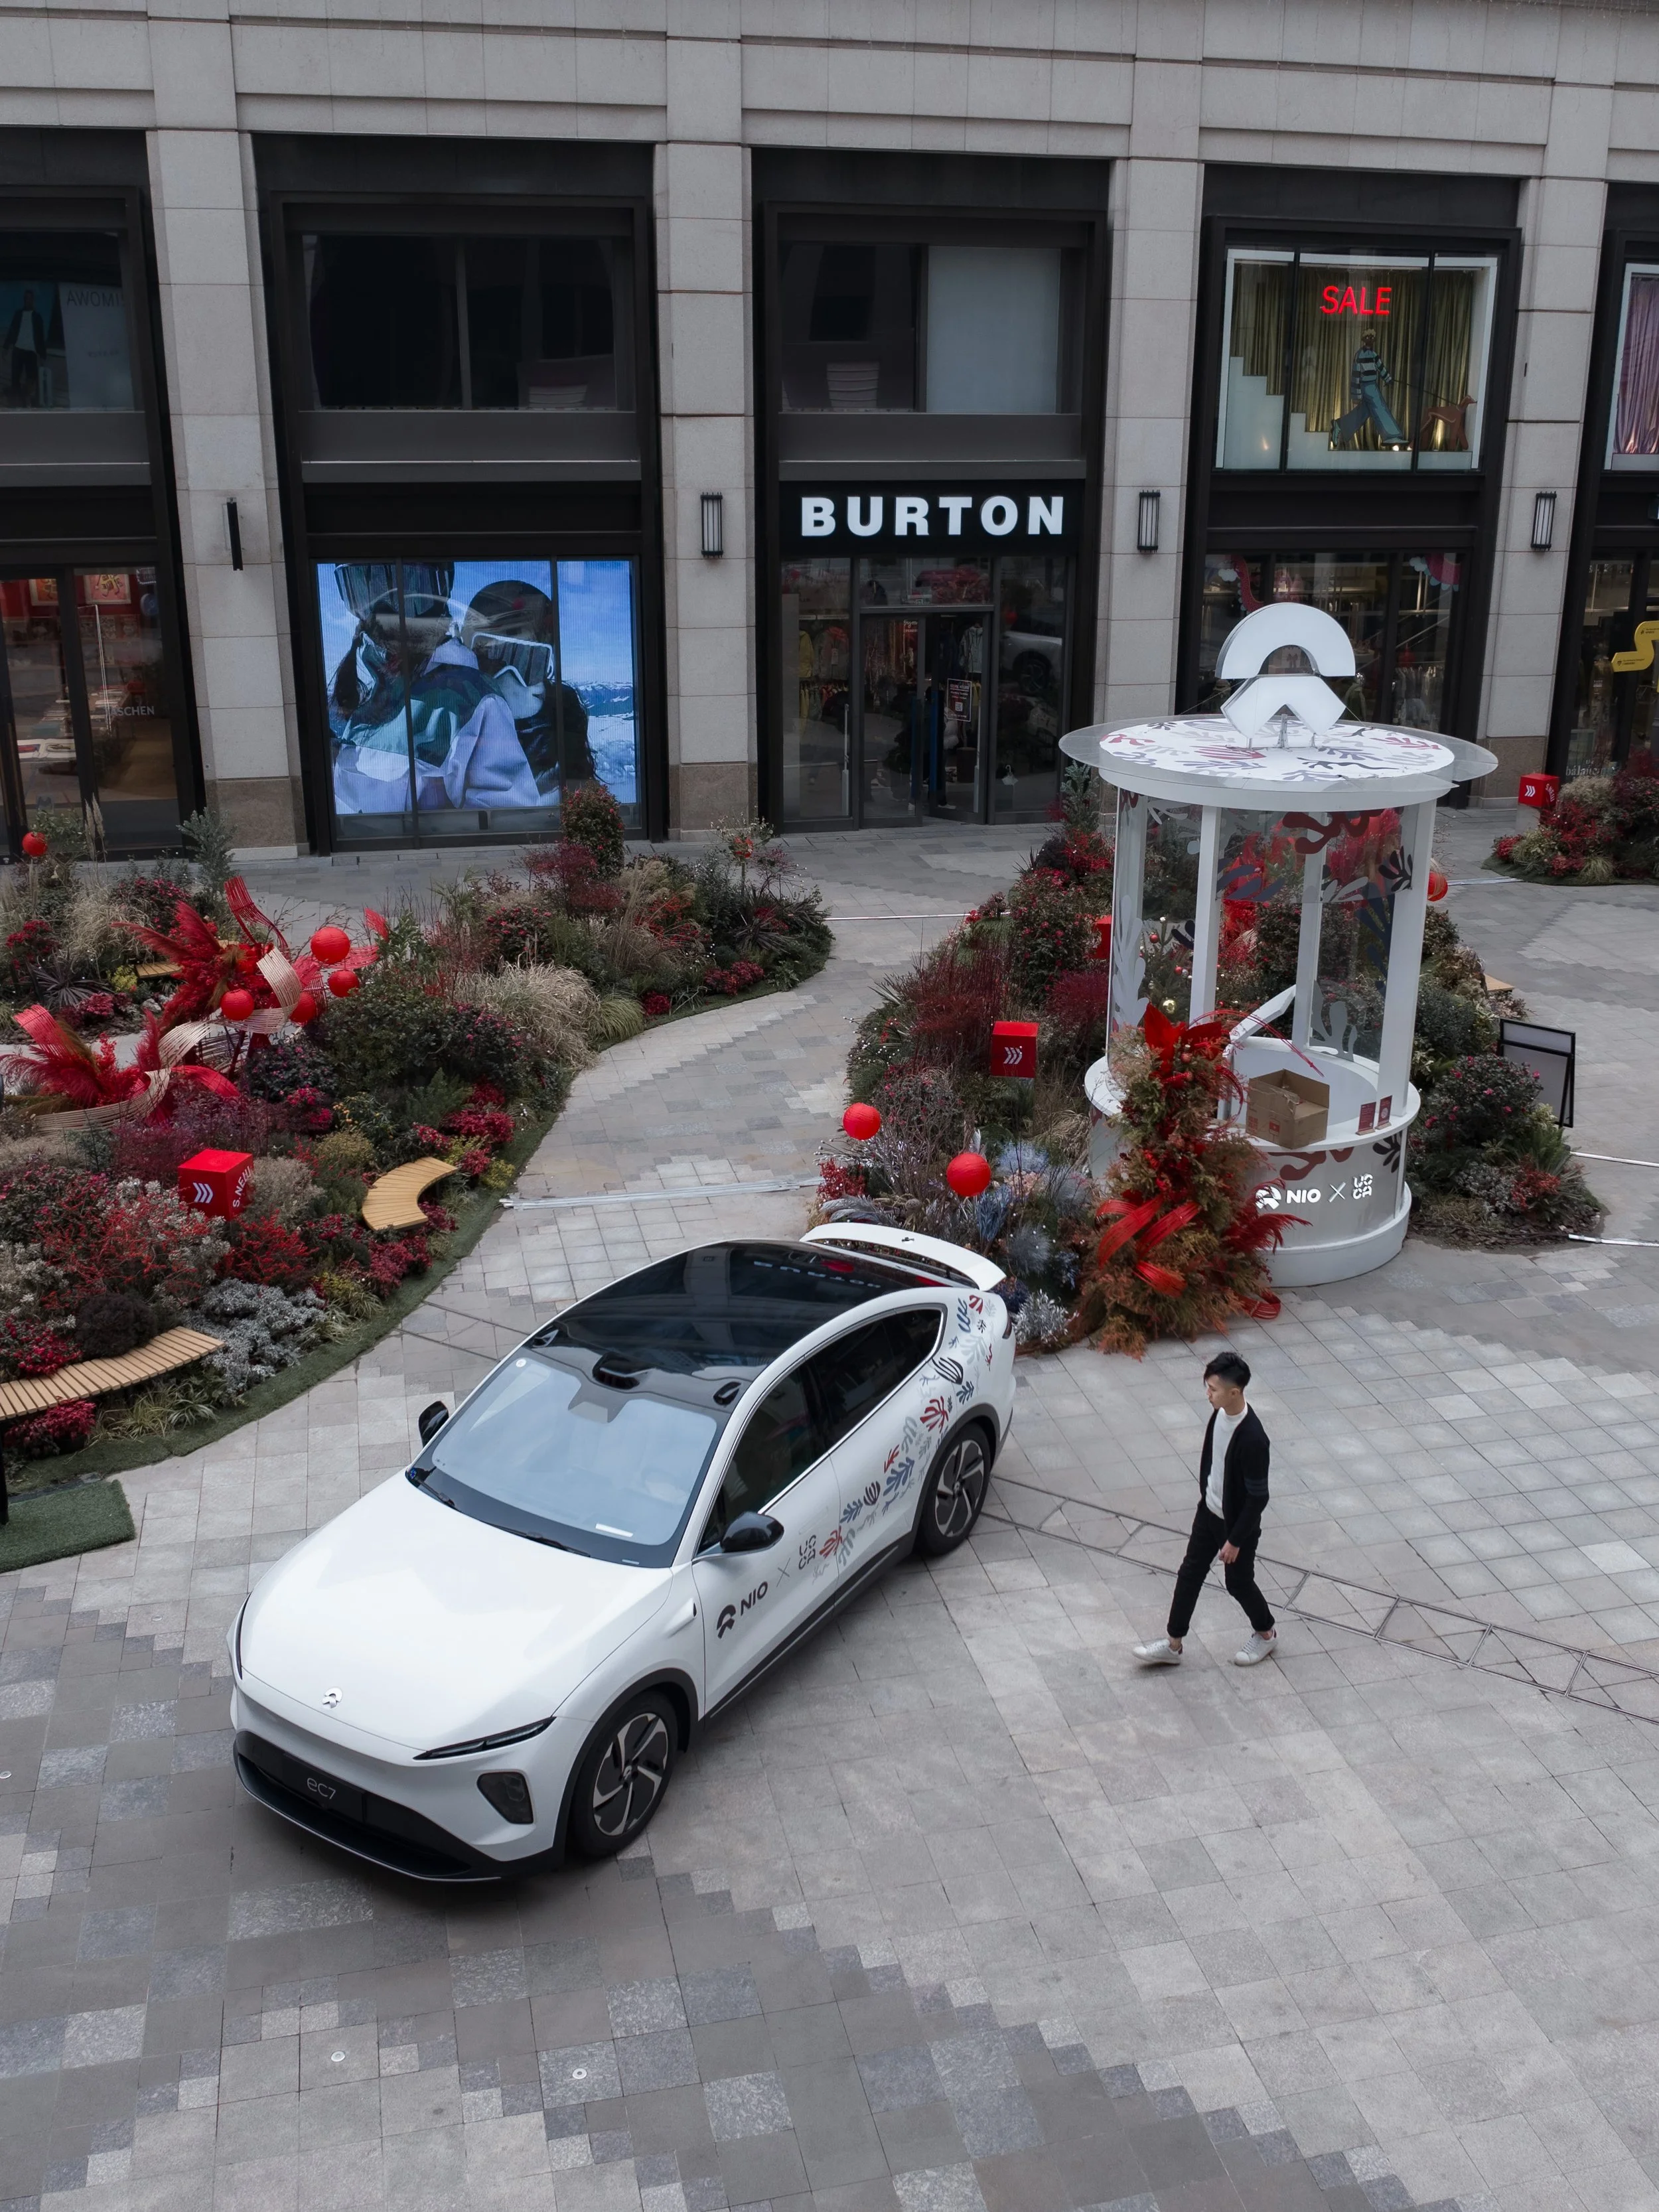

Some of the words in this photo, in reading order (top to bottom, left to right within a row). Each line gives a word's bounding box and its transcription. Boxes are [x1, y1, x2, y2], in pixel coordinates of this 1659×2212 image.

[1320, 285, 1392, 315] SALE
[801, 496, 1064, 537] BURTON
[1286, 1189, 1321, 1204] NIO
[741, 1581, 768, 1617] NIO
